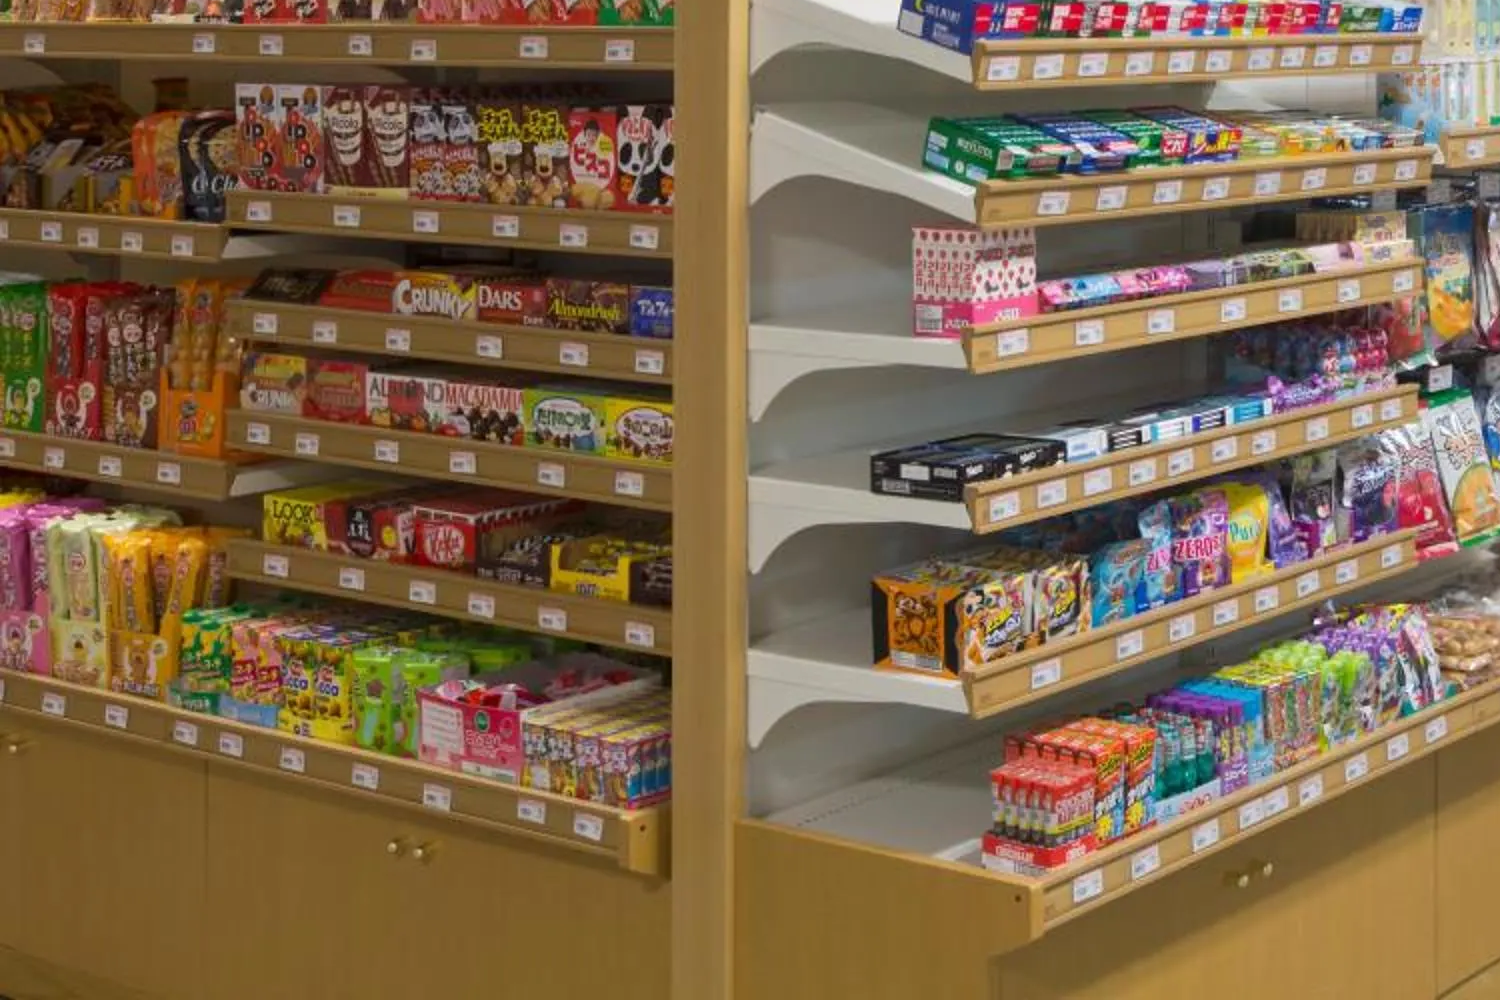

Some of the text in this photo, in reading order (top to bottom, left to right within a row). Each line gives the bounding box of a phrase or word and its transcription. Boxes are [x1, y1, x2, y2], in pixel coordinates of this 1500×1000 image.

[393, 279, 472, 320] CRUNKY
[478, 285, 522, 311] DARS
[272, 500, 314, 523] LOOK
